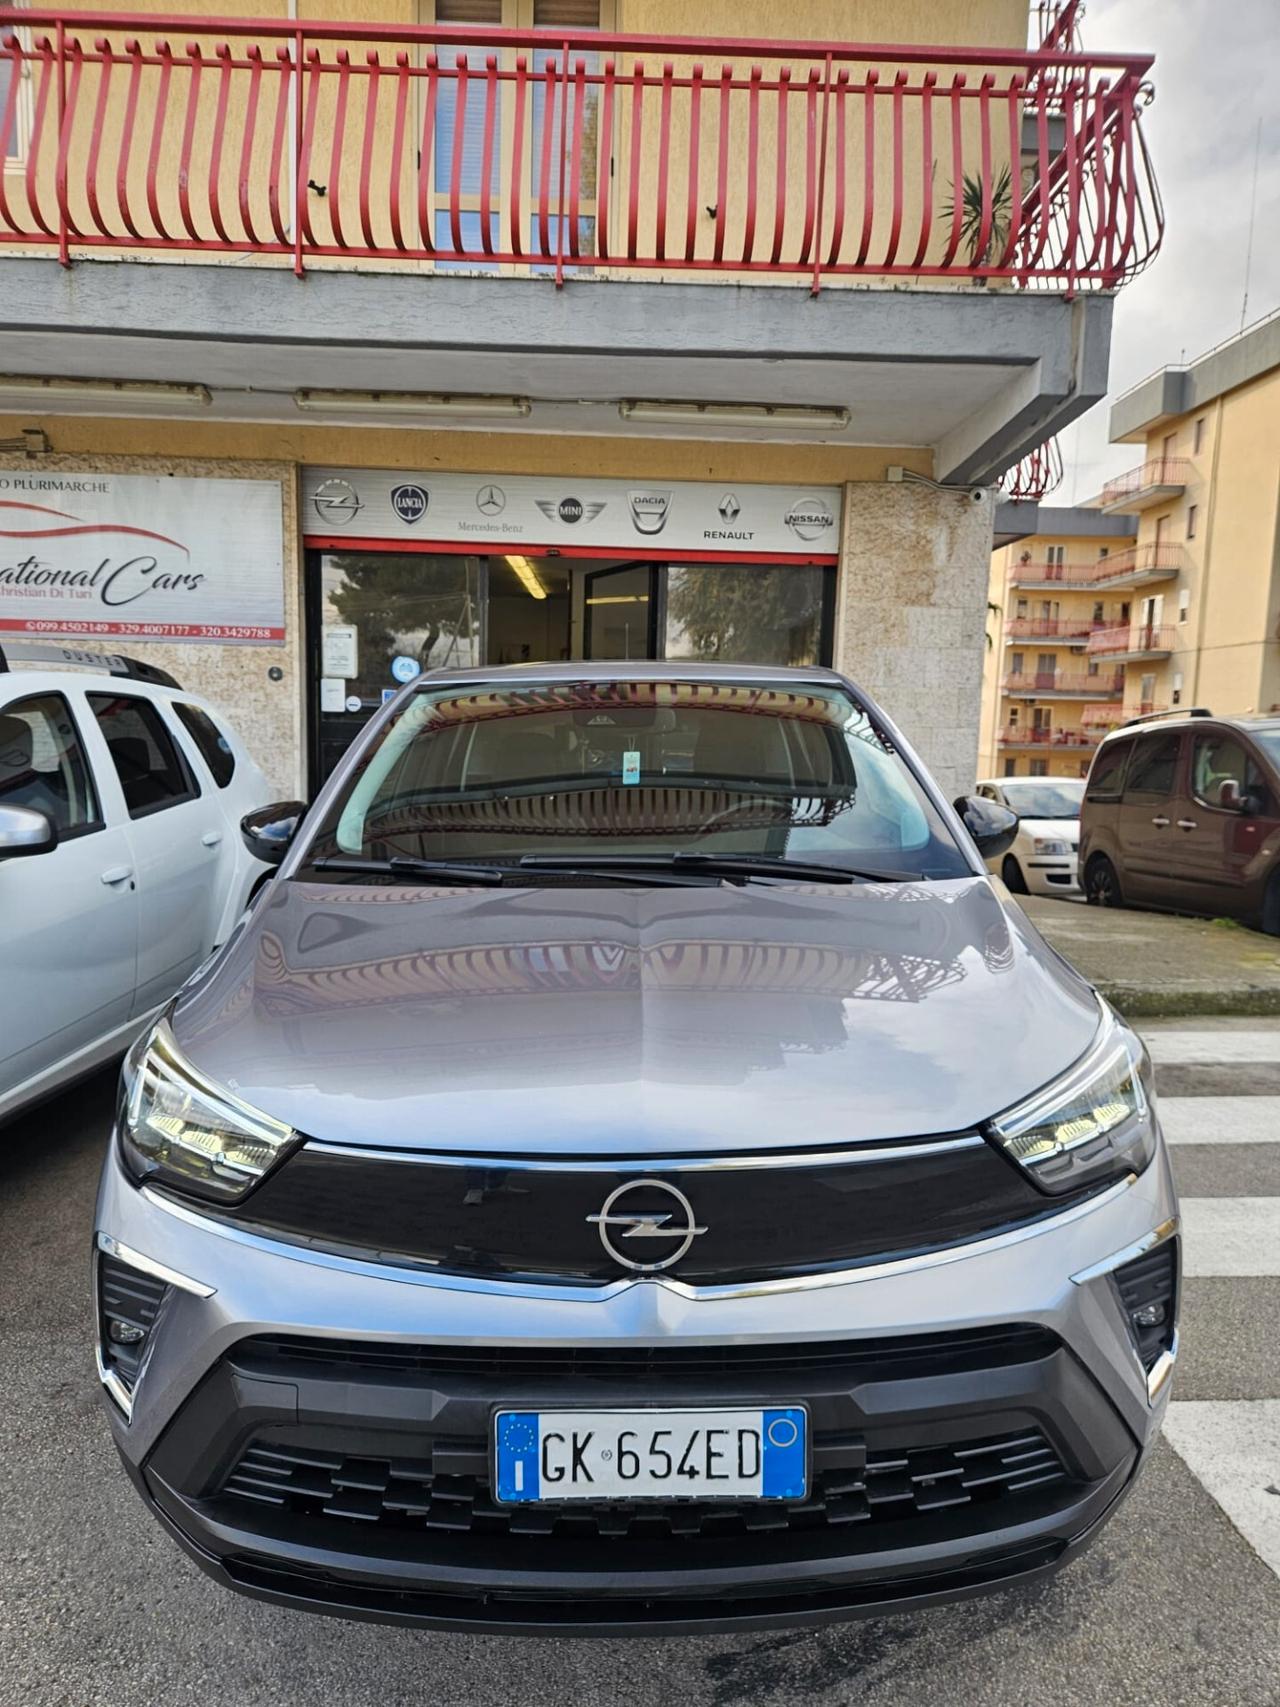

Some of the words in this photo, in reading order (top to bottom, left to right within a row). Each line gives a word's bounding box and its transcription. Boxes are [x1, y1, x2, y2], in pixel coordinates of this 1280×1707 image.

[14, 479, 111, 493] PLURIMARCHE
[397, 497, 423, 508] LANCIA
[634, 496, 666, 505] DACIA
[559, 506, 582, 516] MINI
[789, 514, 830, 523] NISSAN
[458, 521, 523, 534] Mercedes-Benz
[704, 531, 755, 540] RENAULT
[101, 555, 205, 606] Cars
[0, 585, 46, 597] hristian
[119, 624, 190, 635] 329.4007177
[200, 627, 272, 639] 320.3429788
[542, 1431, 595, 1482] GK
[617, 1429, 761, 1480] 654ED
